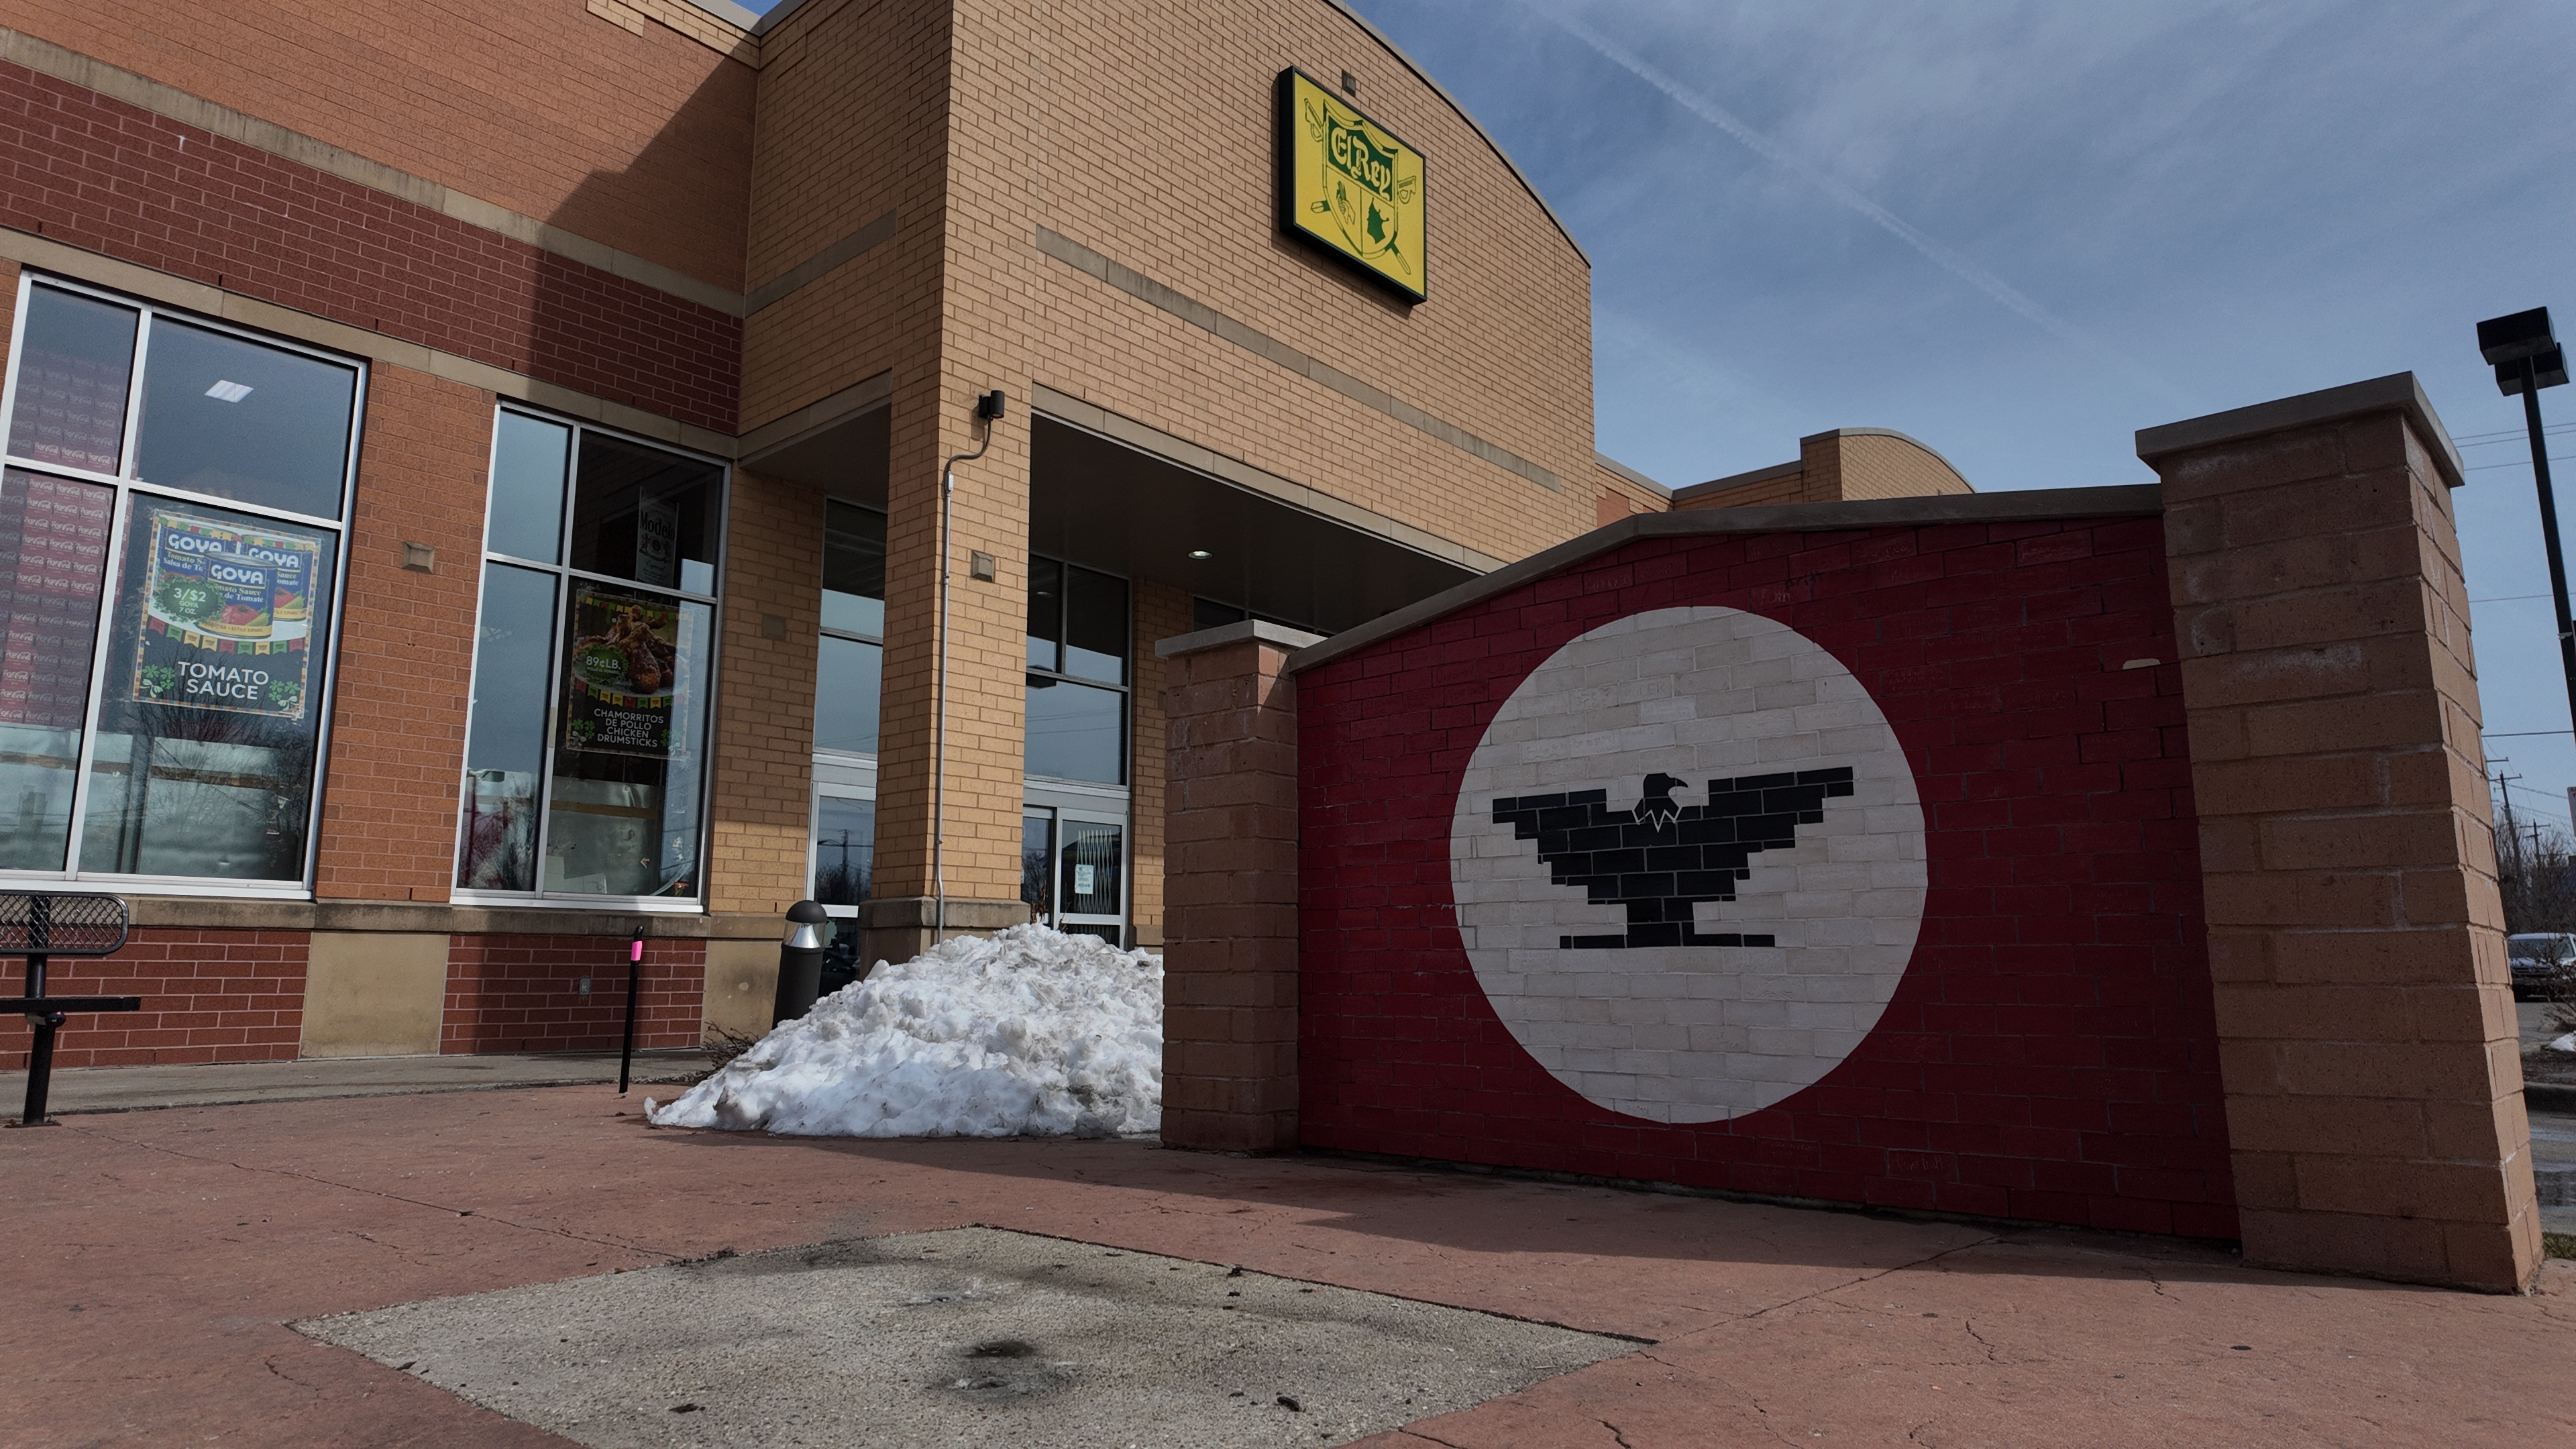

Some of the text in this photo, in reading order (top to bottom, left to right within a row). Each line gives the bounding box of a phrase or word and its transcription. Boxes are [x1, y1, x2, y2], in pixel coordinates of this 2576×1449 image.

[1331, 126, 1391, 201] El Rey
[640, 511, 676, 541] Modelo
[168, 534, 222, 553] GOYA
[167, 551, 195, 564] Tomato
[249, 547, 299, 568] GOYA
[211, 565, 264, 584] GOYA
[174, 588, 207, 602] 3/$2
[235, 593, 264, 602] Tomate
[239, 586, 262, 596] Sauce
[178, 661, 269, 686] TOMATO
[186, 679, 258, 700] SAUCE
[594, 708, 664, 724] CHAMORRITOS
[605, 718, 652, 731] DE POLLO
[606, 727, 649, 738] CHICKEN
[597, 733, 657, 747] DRUMSTICKS
